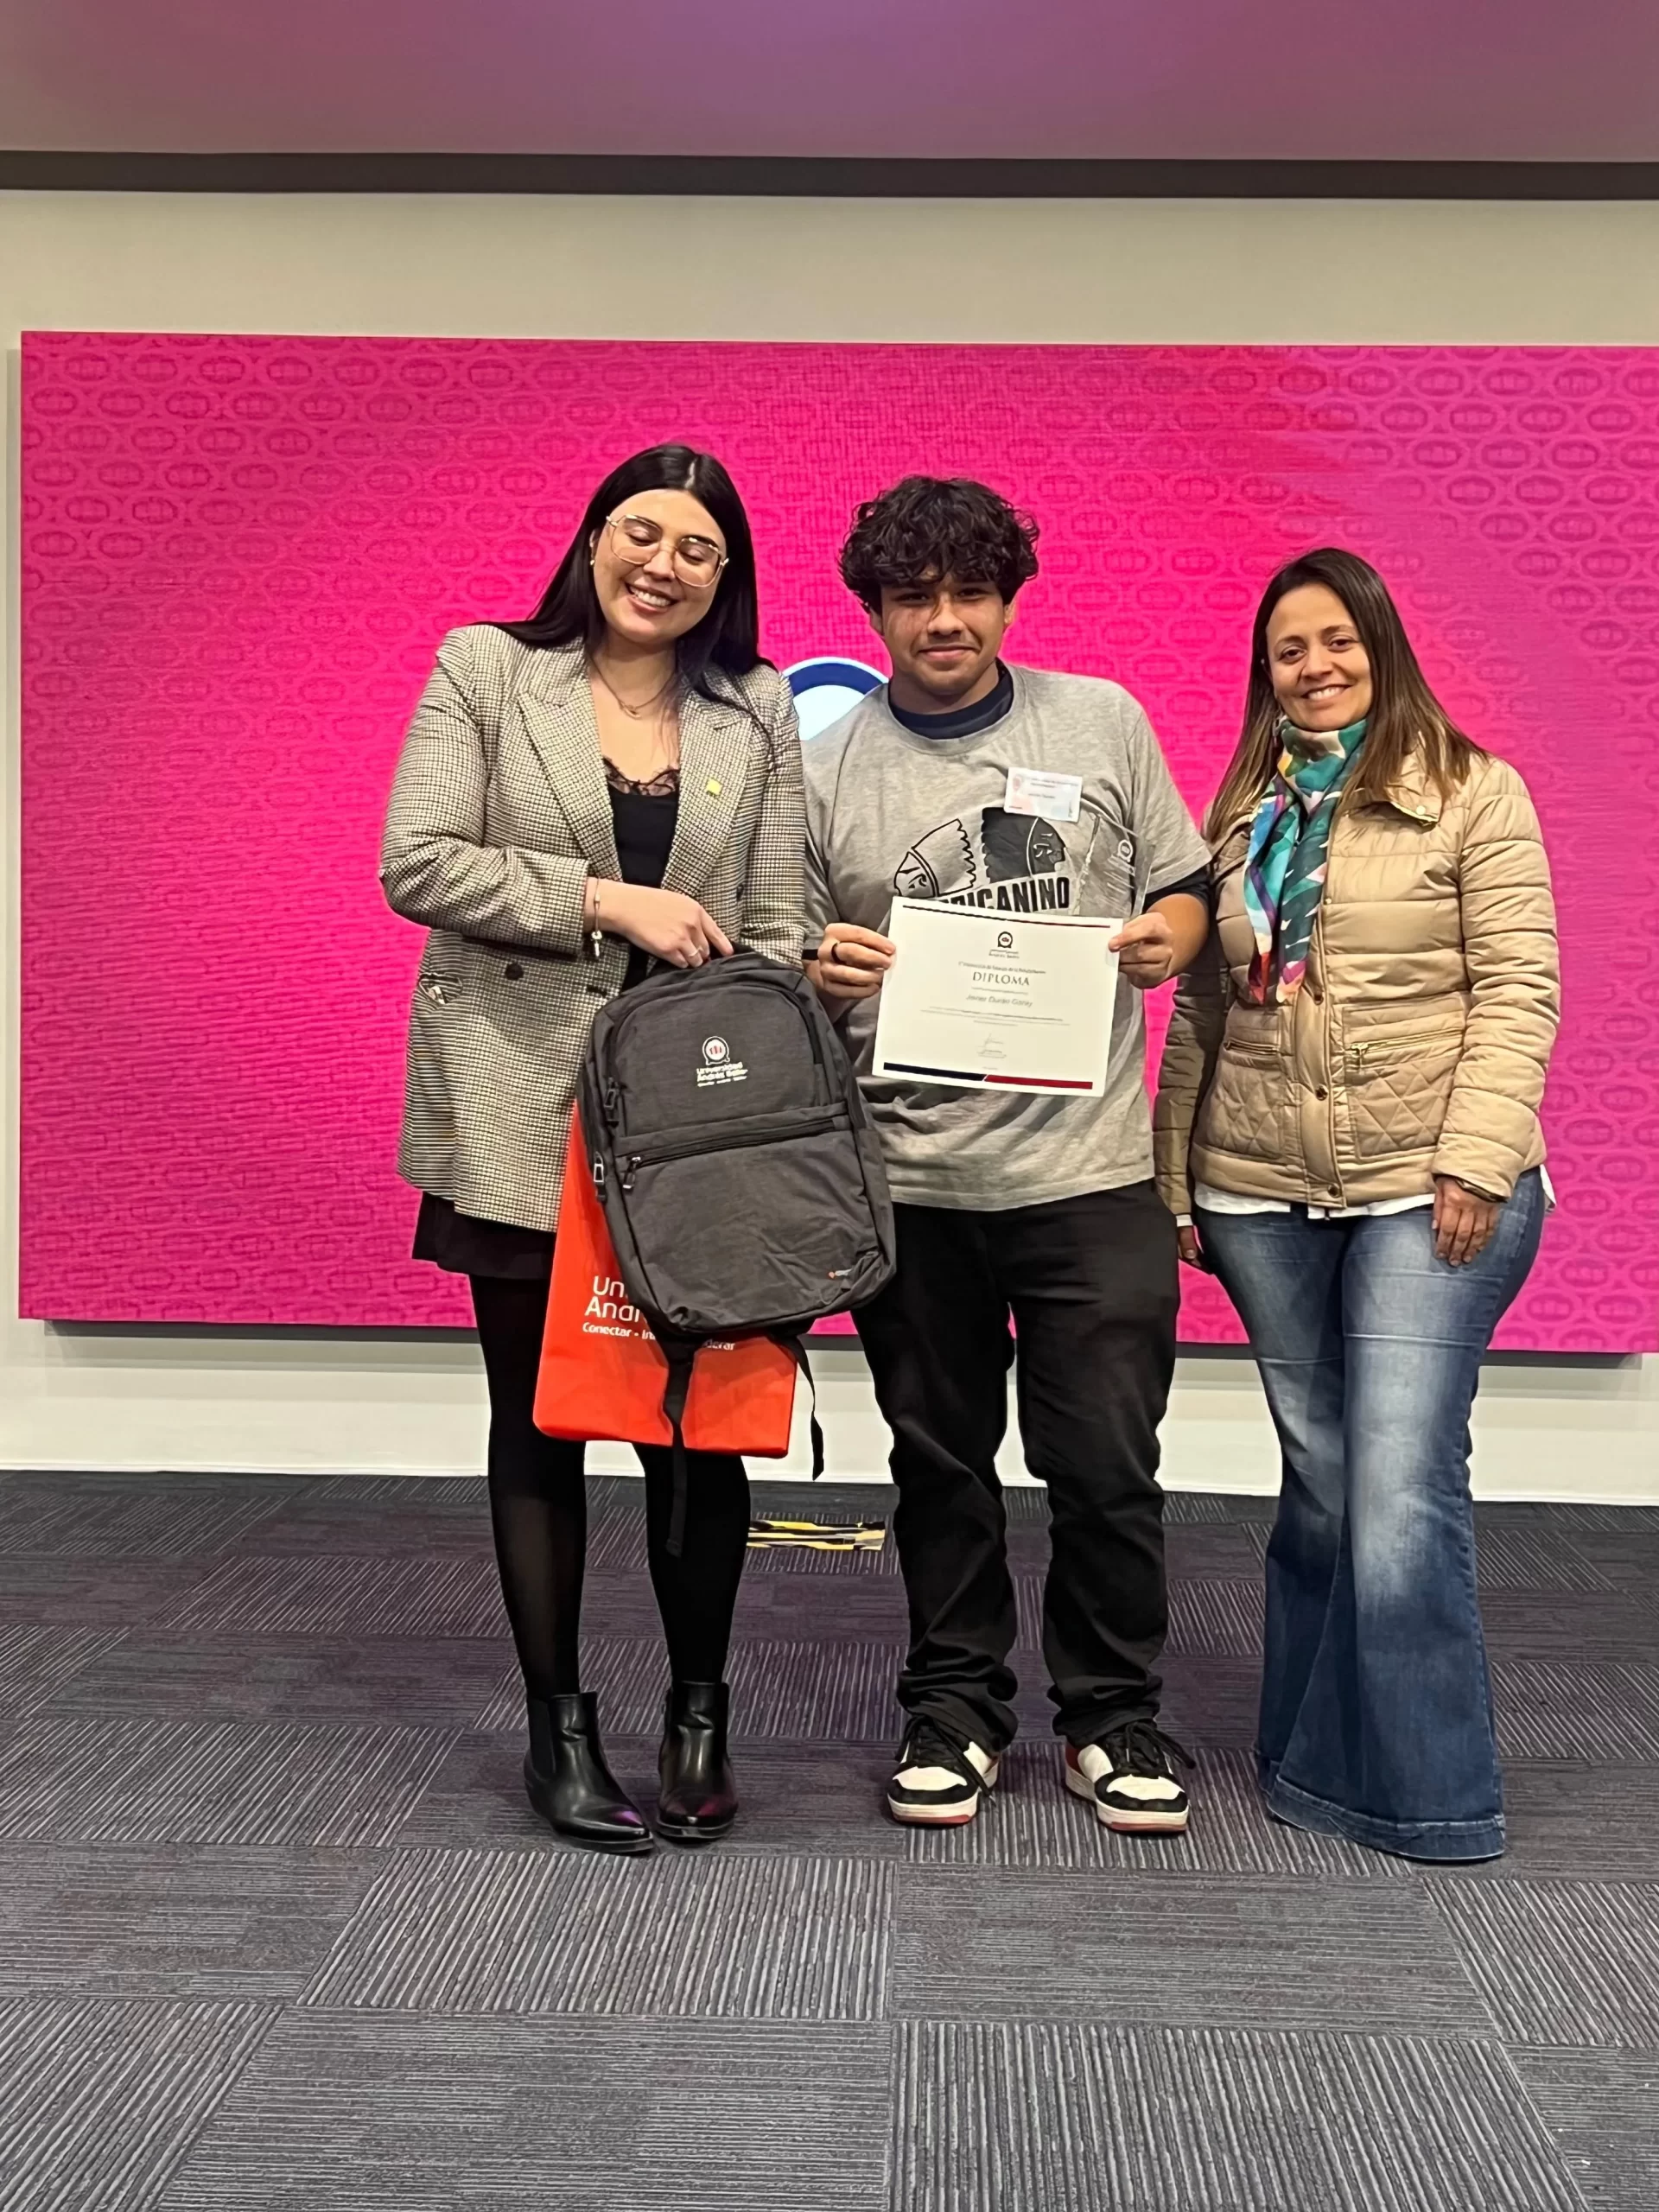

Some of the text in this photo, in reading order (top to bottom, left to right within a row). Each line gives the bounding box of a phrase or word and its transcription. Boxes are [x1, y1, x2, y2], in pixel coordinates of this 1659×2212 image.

[972, 971, 1030, 986] DIPLOMA
[593, 1275, 626, 1299] Un
[582, 1322, 632, 1338] Conectar
